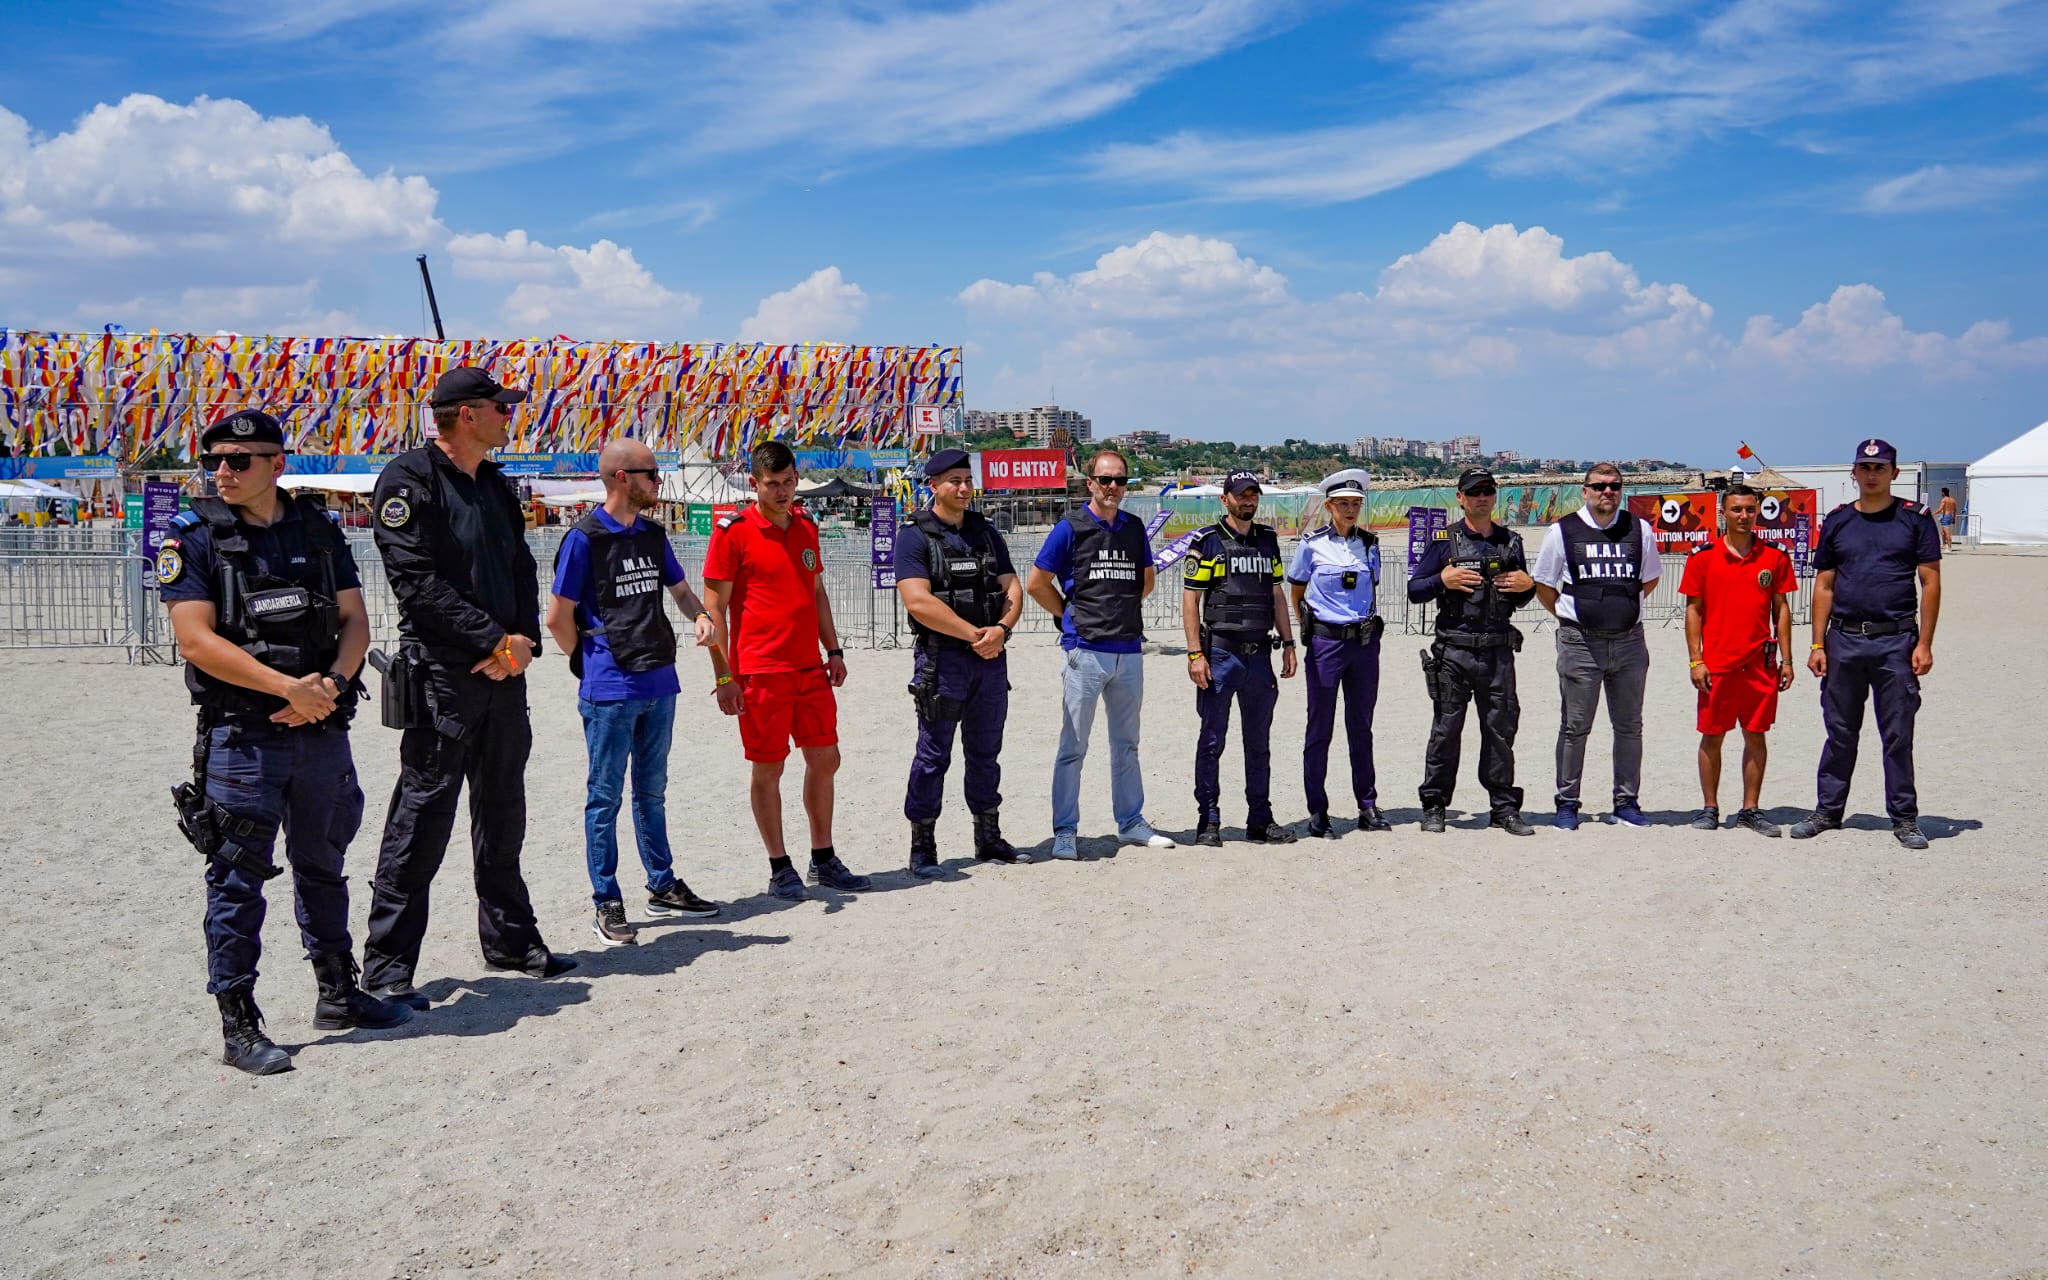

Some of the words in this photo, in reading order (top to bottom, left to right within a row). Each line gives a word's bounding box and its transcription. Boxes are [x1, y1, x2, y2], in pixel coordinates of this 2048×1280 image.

[869, 451, 906, 459] WOMEN
[83, 458, 113, 467] MEN
[989, 460, 1009, 478] NO
[1012, 460, 1058, 477] ENTRY
[400, 488, 408, 497] 3
[1653, 531, 1682, 542] LUTION
[1684, 530, 1708, 542] POINT
[1753, 528, 1783, 540] UTION
[1784, 528, 1796, 539] PO
[1098, 549, 1129, 561] M.A.I.
[1585, 543, 1626, 558] M.A.I.
[1088, 569, 1137, 581] ANTIDROG
[1578, 562, 1635, 579] A.N.I.T.P.
[254, 594, 303, 613] JANDARMERIA
